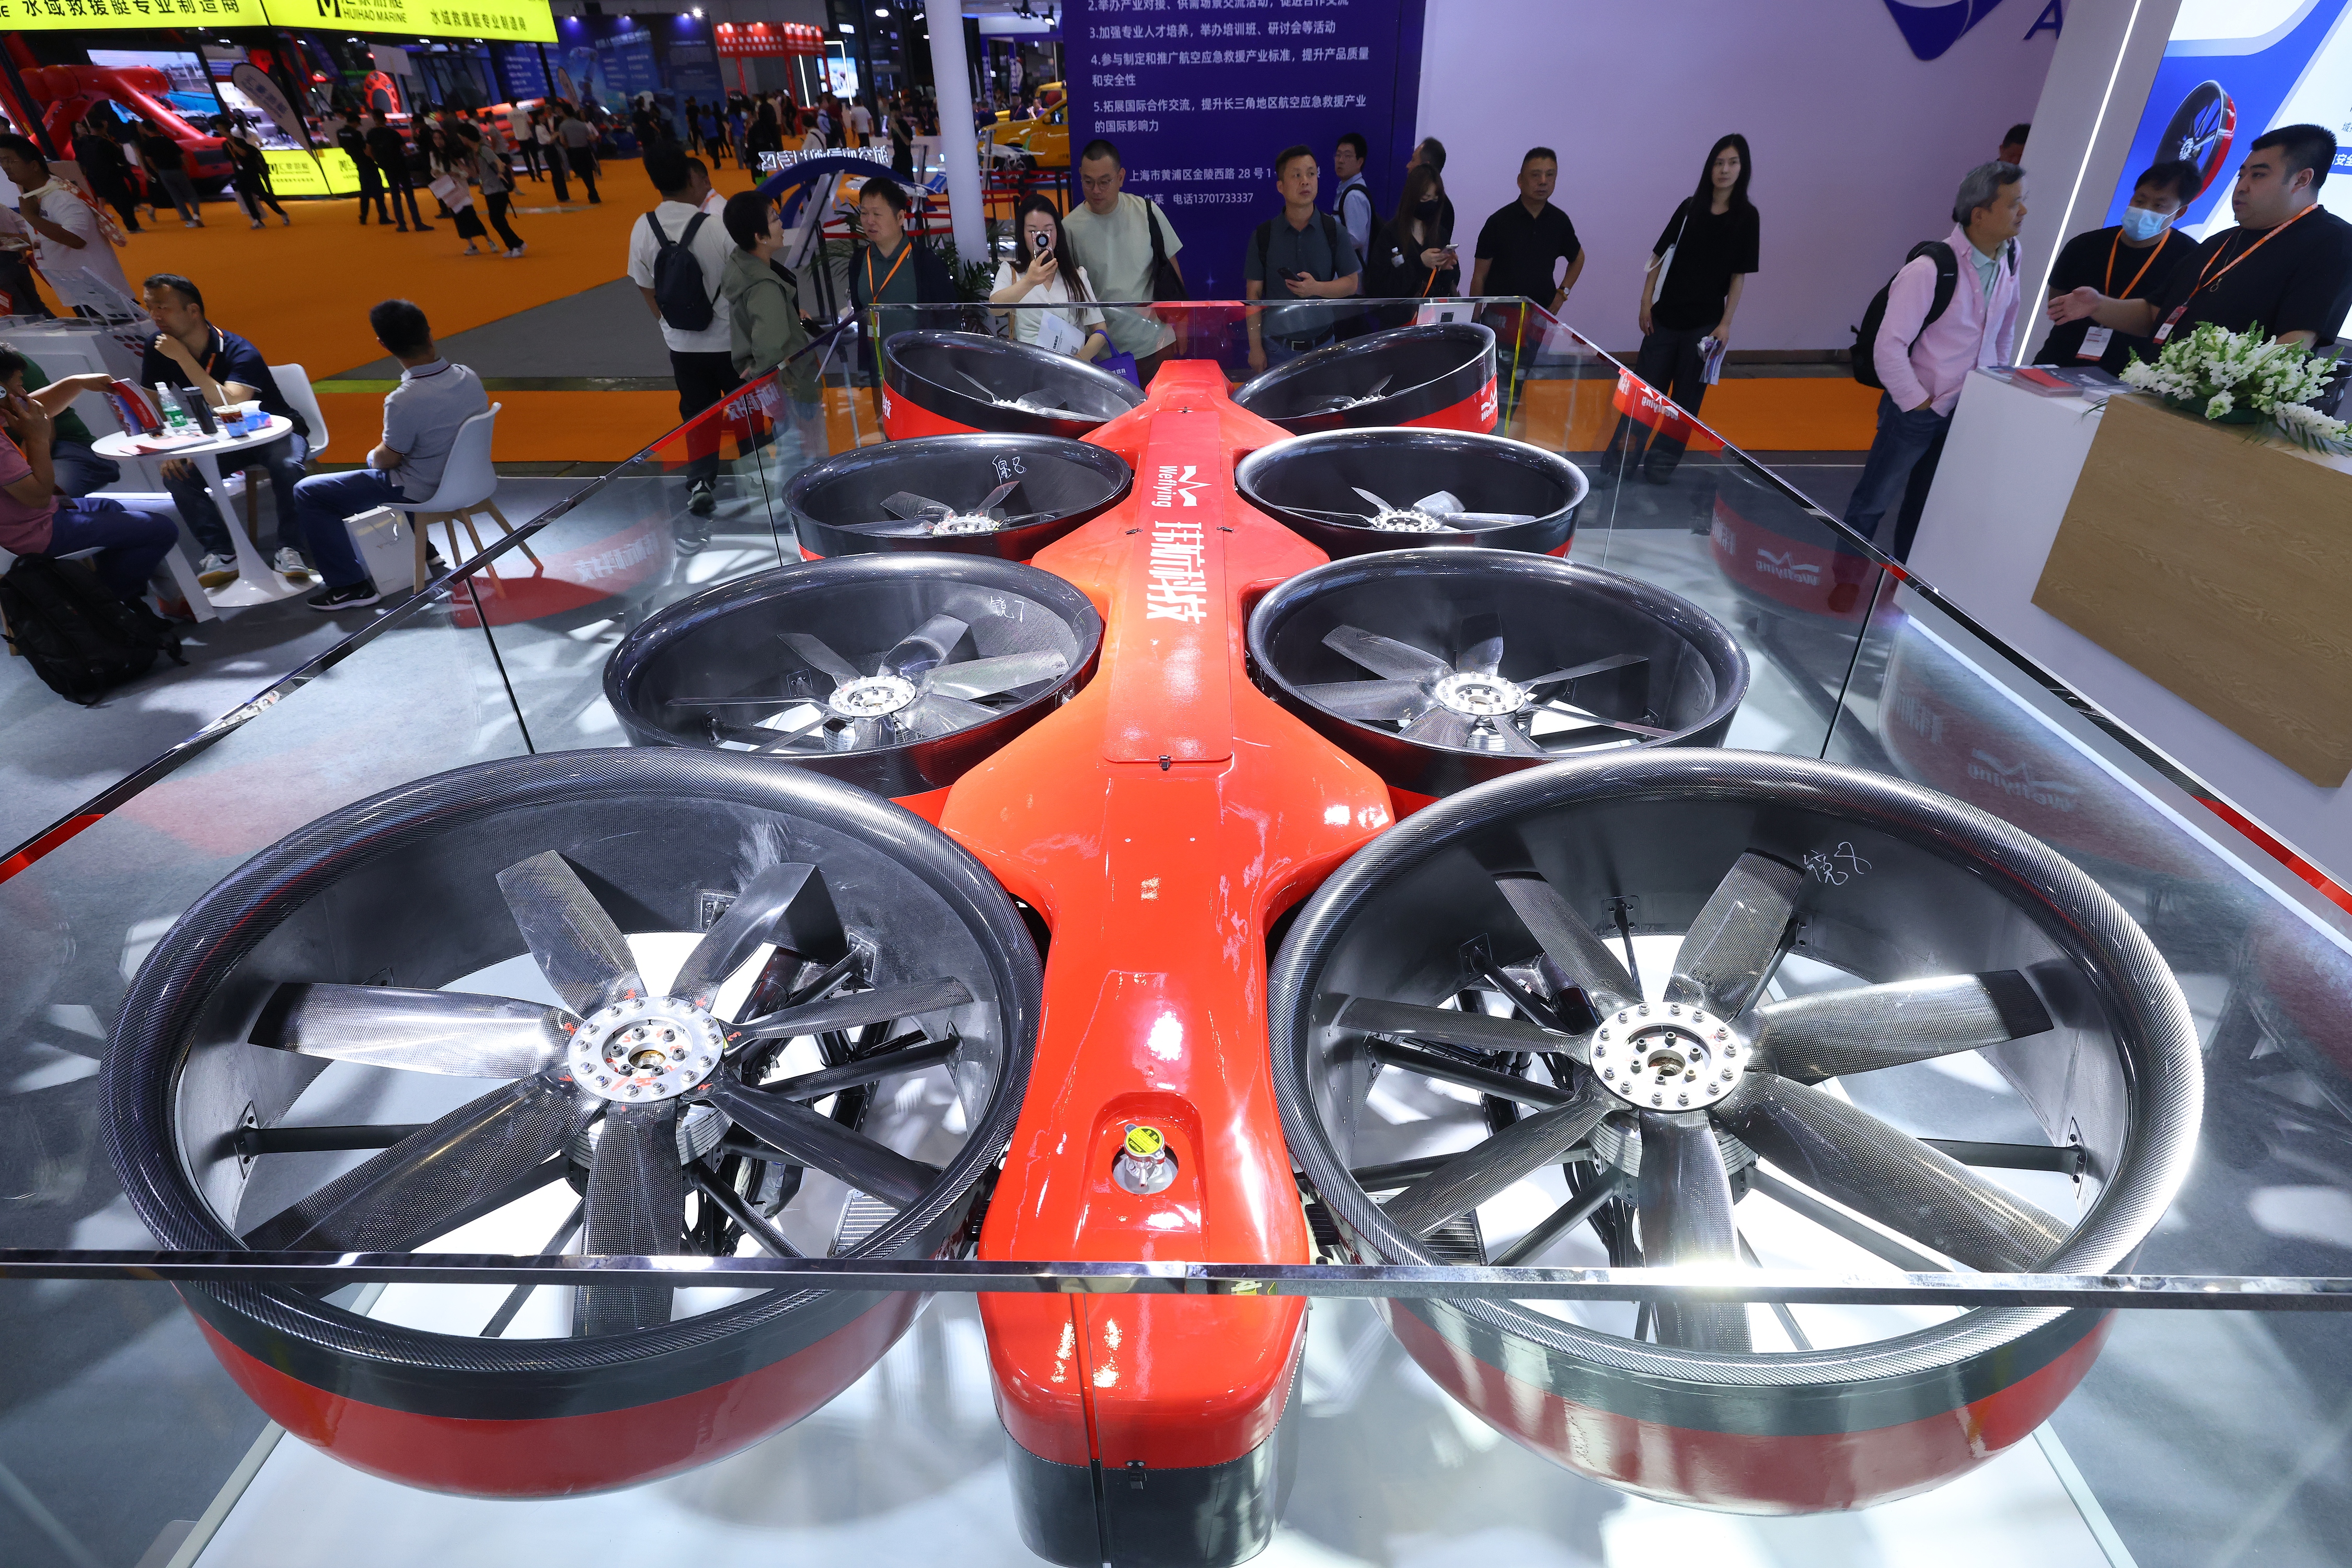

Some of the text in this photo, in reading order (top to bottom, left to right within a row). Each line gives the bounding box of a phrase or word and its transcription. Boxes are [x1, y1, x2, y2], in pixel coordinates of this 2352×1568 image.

[376, 10, 408, 24] MARINE
[1092, 73, 1136, 87] 和安全性
[1094, 119, 1159, 133] 的国际影响力
[1129, 168, 1235, 182] 上海市黄浦区金陵西路
[1238, 168, 1251, 179] 28
[1253, 167, 1264, 179] 号
[1151, 466, 1178, 508] Weflying
[1129, 1140, 1143, 1152] CAUTION
